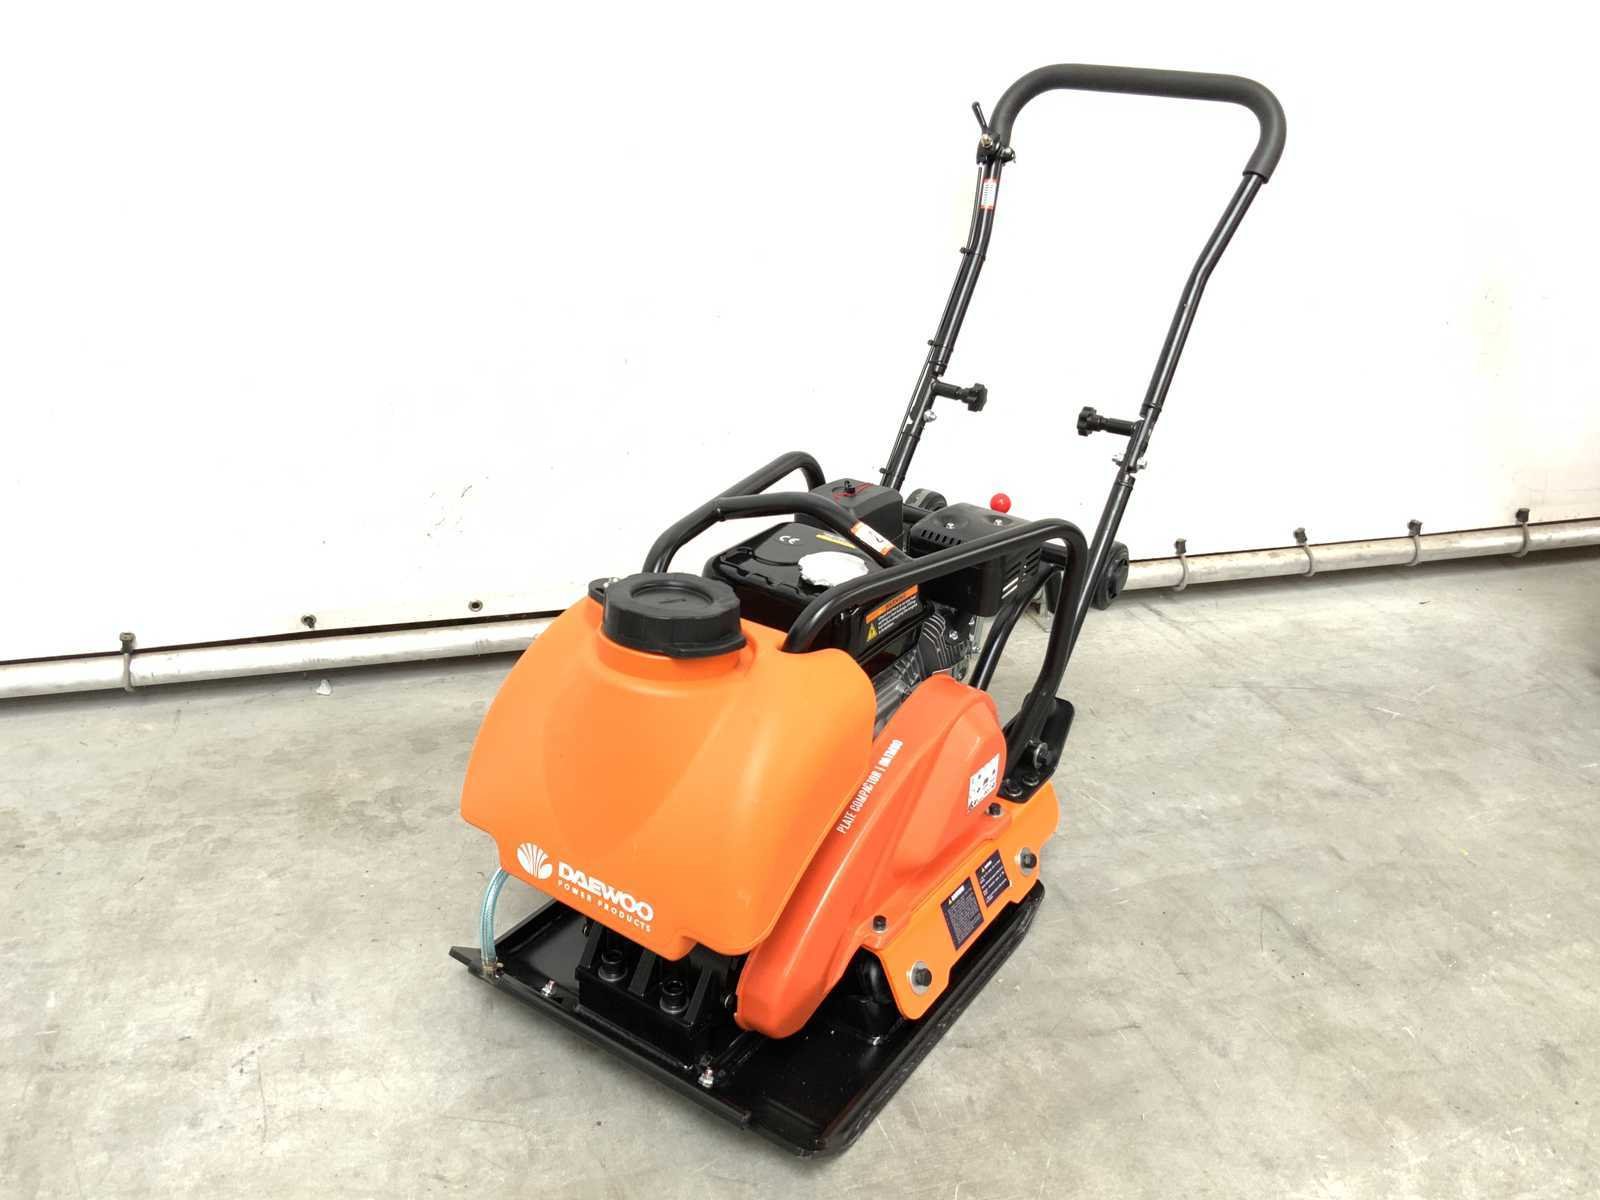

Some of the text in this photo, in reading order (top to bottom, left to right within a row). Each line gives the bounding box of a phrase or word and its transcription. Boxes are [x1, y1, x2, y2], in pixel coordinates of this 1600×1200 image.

[836, 810, 857, 834] PLATE
[849, 770, 883, 813] COMPACTOR
[557, 879, 652, 933] POWER PRODUCTS
[558, 860, 654, 922] DAEWOO
